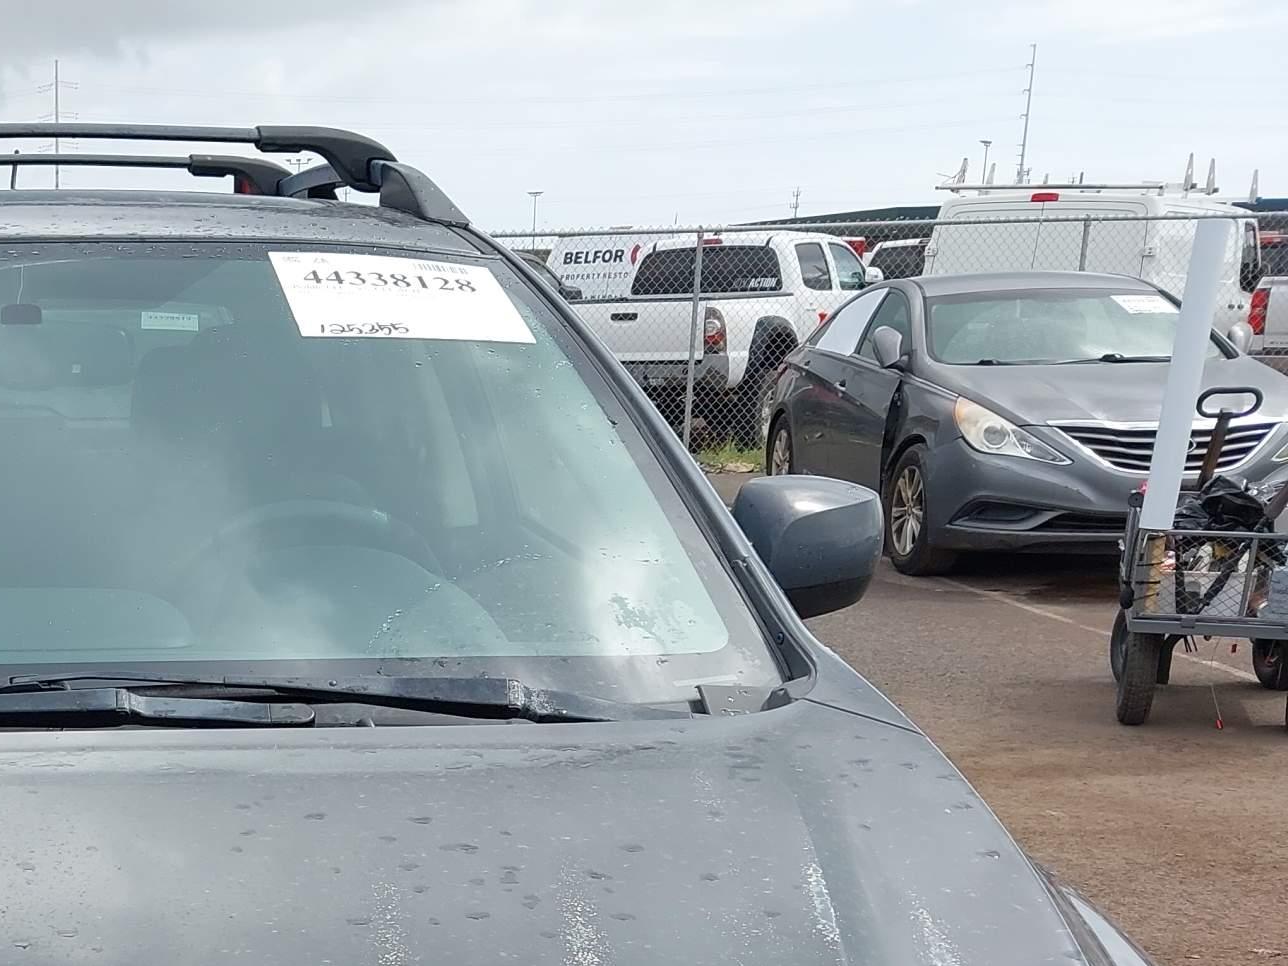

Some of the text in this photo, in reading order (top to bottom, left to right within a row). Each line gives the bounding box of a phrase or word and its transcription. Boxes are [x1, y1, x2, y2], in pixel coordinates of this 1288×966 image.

[562, 249, 625, 265] BELFOR
[303, 269, 477, 293] 44338128
[602, 271, 631, 279] RESTO
